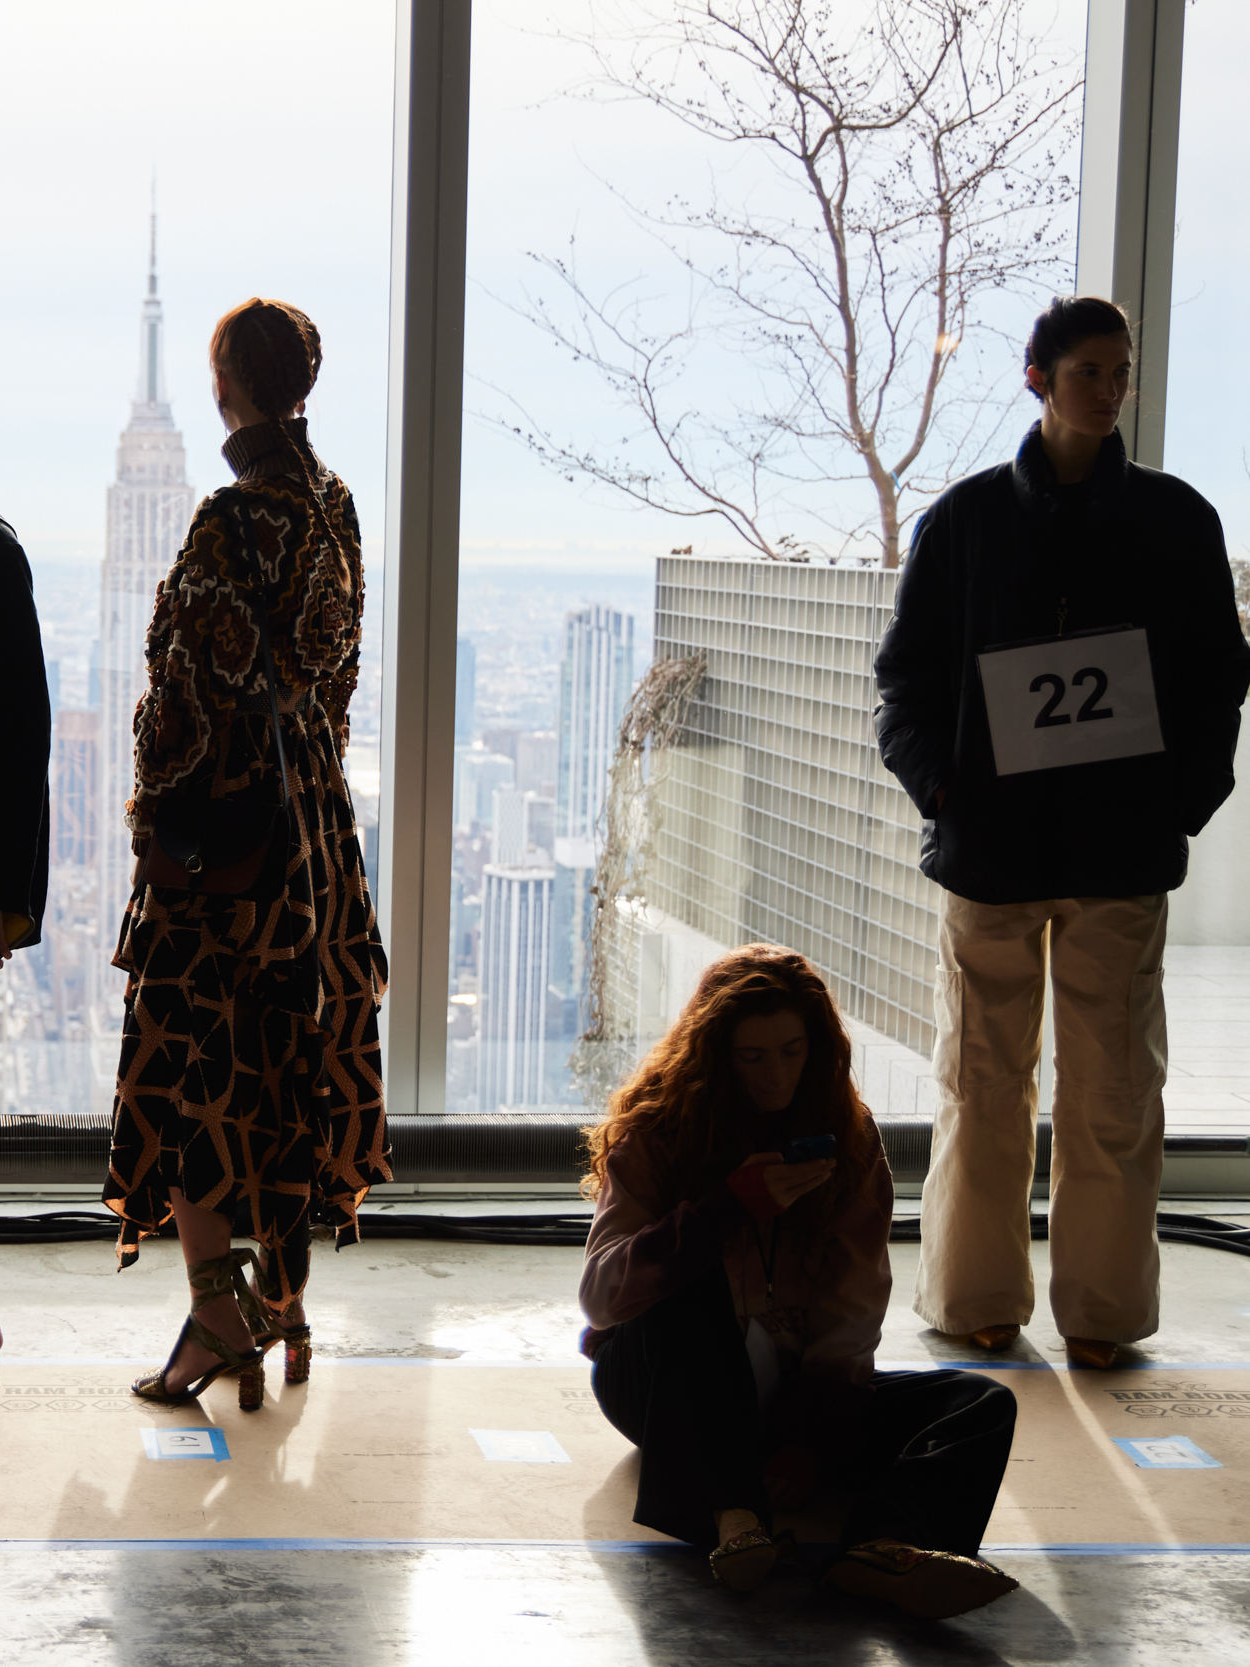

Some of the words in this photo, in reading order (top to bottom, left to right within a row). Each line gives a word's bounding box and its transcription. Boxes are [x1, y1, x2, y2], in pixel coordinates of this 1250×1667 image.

[1029, 666, 1114, 729] 22
[4, 1386, 66, 1395] RAM
[77, 1387, 133, 1396] BOA
[559, 1390, 596, 1398] RA
[1110, 1391, 1177, 1400] RAM
[169, 1435, 201, 1447] 19
[1146, 1445, 1188, 1458] 22
